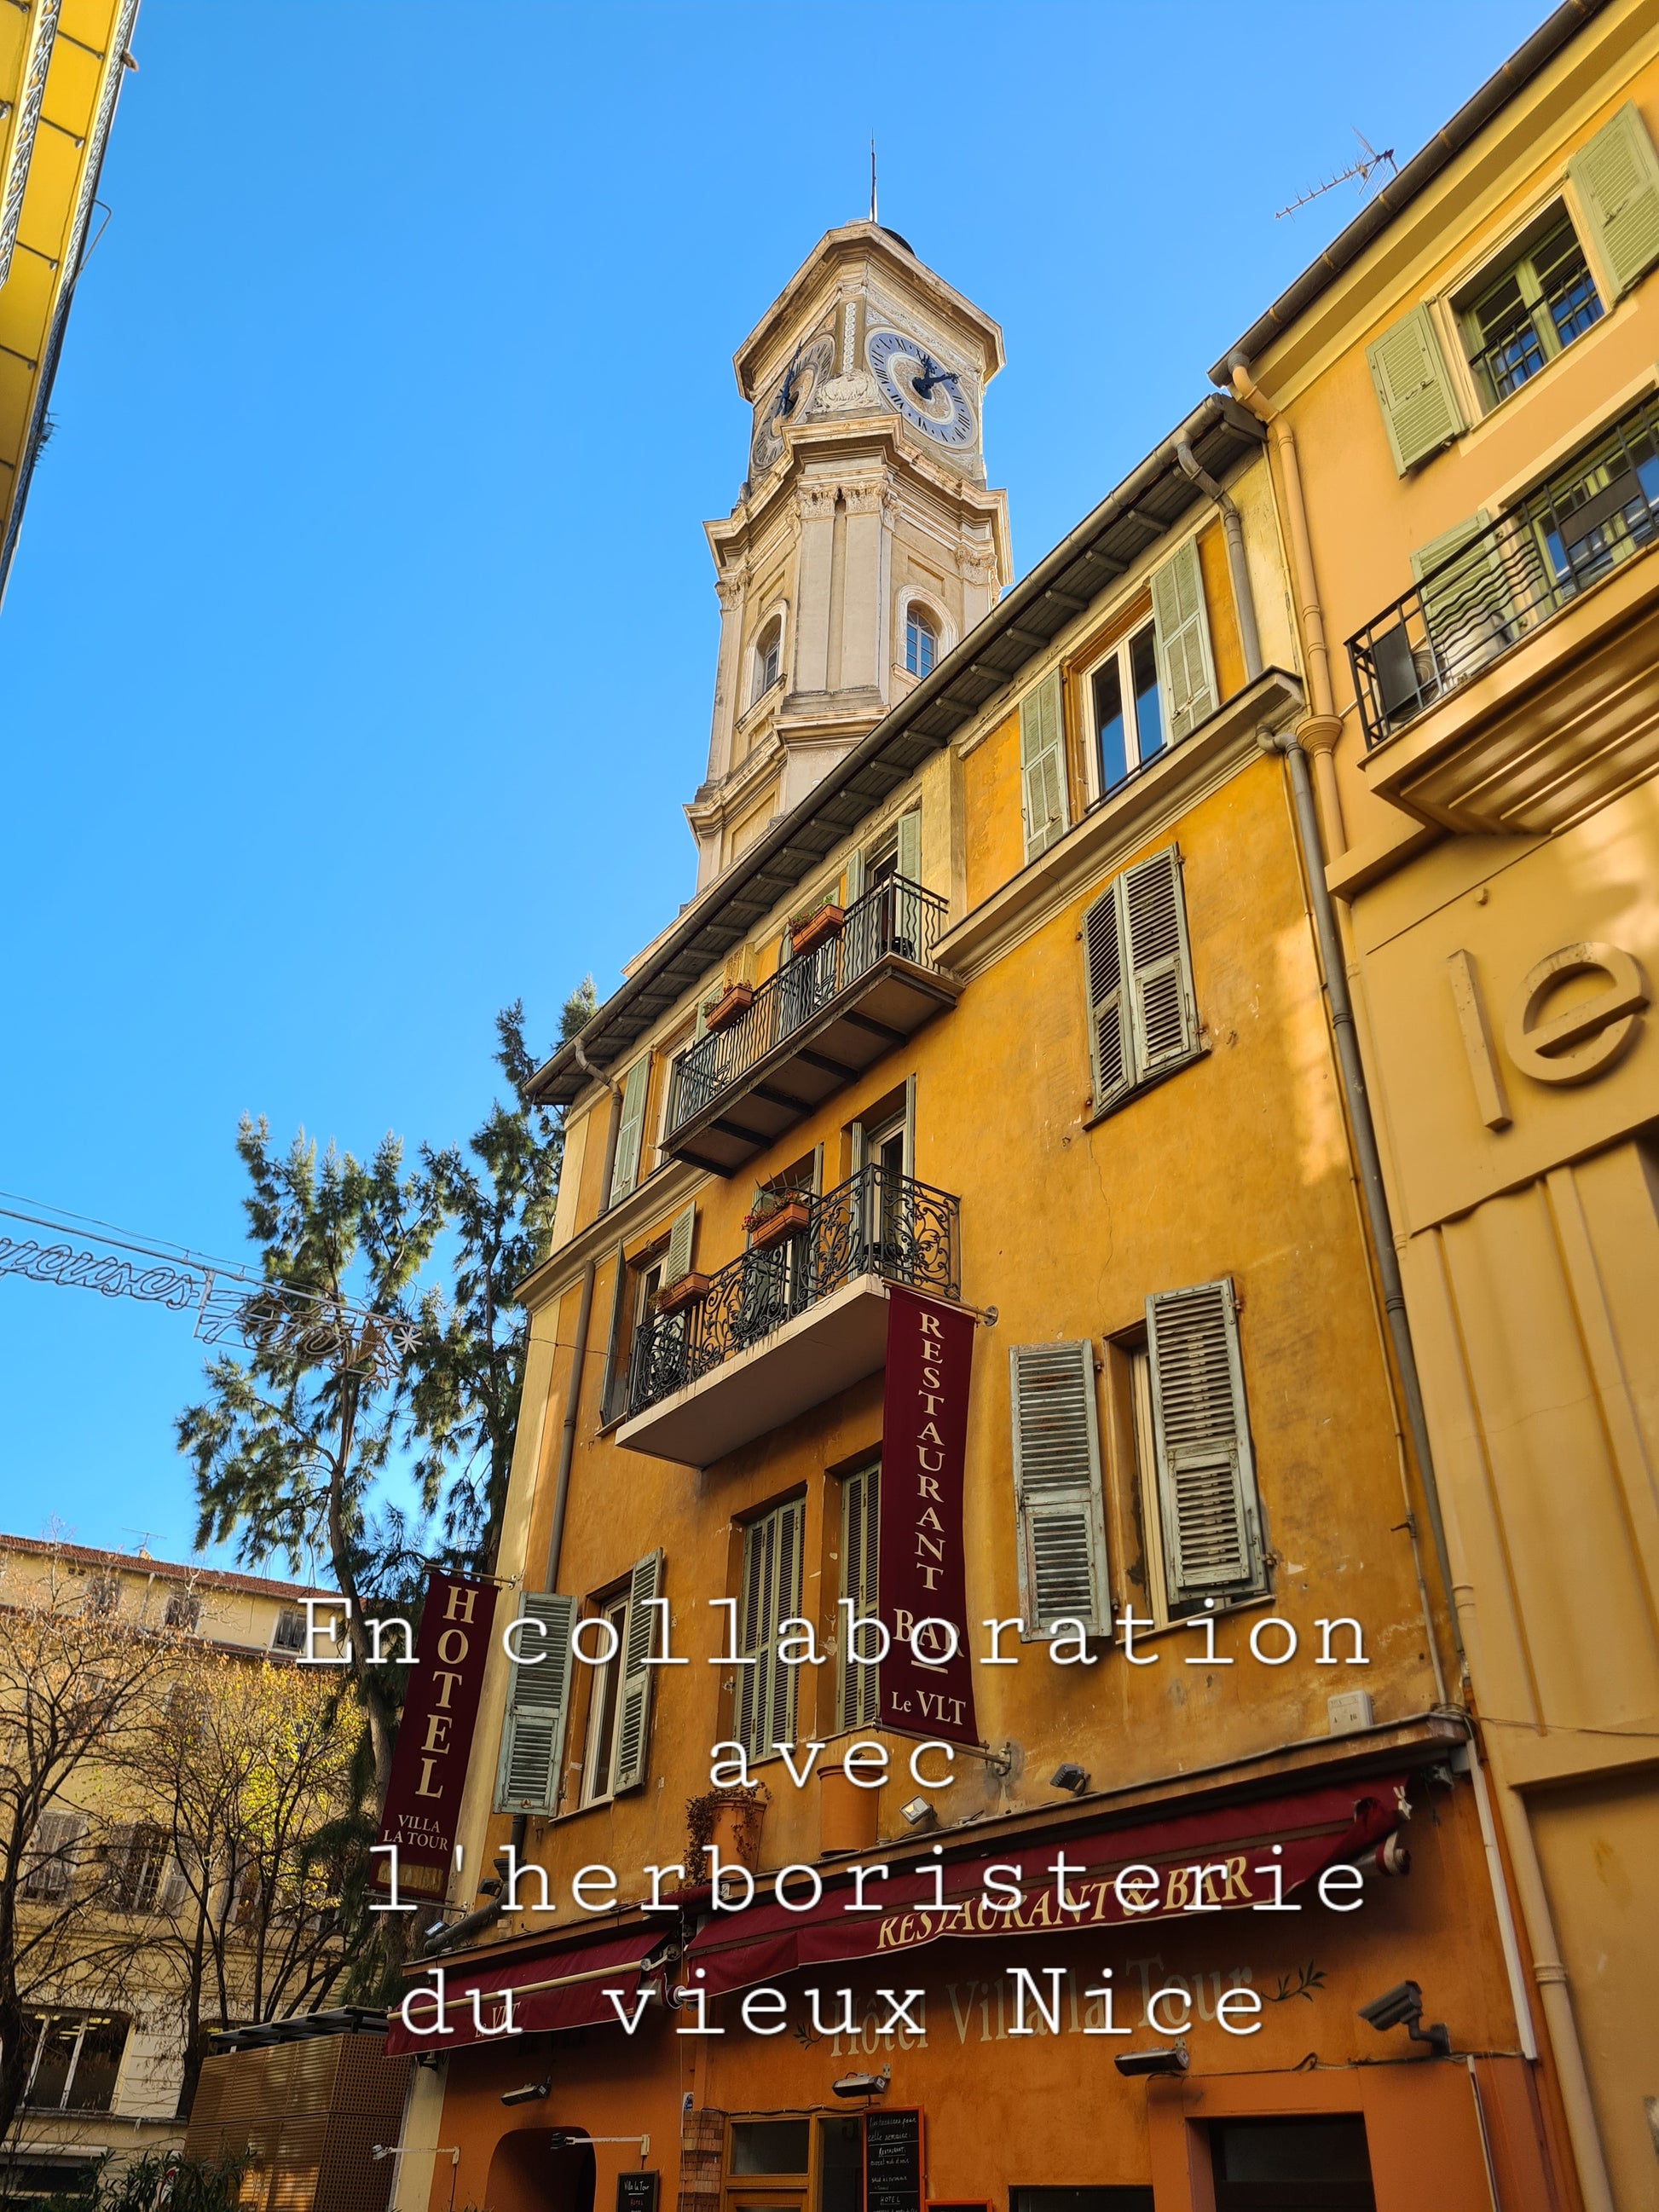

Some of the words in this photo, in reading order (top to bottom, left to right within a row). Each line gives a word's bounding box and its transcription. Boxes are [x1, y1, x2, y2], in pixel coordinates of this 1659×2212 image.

[1446, 941, 1651, 1133] le
[915, 1311, 945, 1591] RESTAURANT
[891, 1607, 967, 1659] BAR
[414, 1584, 479, 1799] HOTEL
[890, 1690, 912, 1712] Le
[915, 1689, 968, 1725] VLT
[382, 1829, 403, 1843] LA
[407, 1831, 448, 1851] TOUR
[397, 1814, 441, 1834] VILLA
[876, 1880, 1120, 1949] RESTAURANT
[1166, 1856, 1252, 1911] BAR
[830, 1995, 929, 2058] Hôtel
[945, 1980, 1049, 2045] Villa
[1126, 1953, 1254, 2027] Tour
